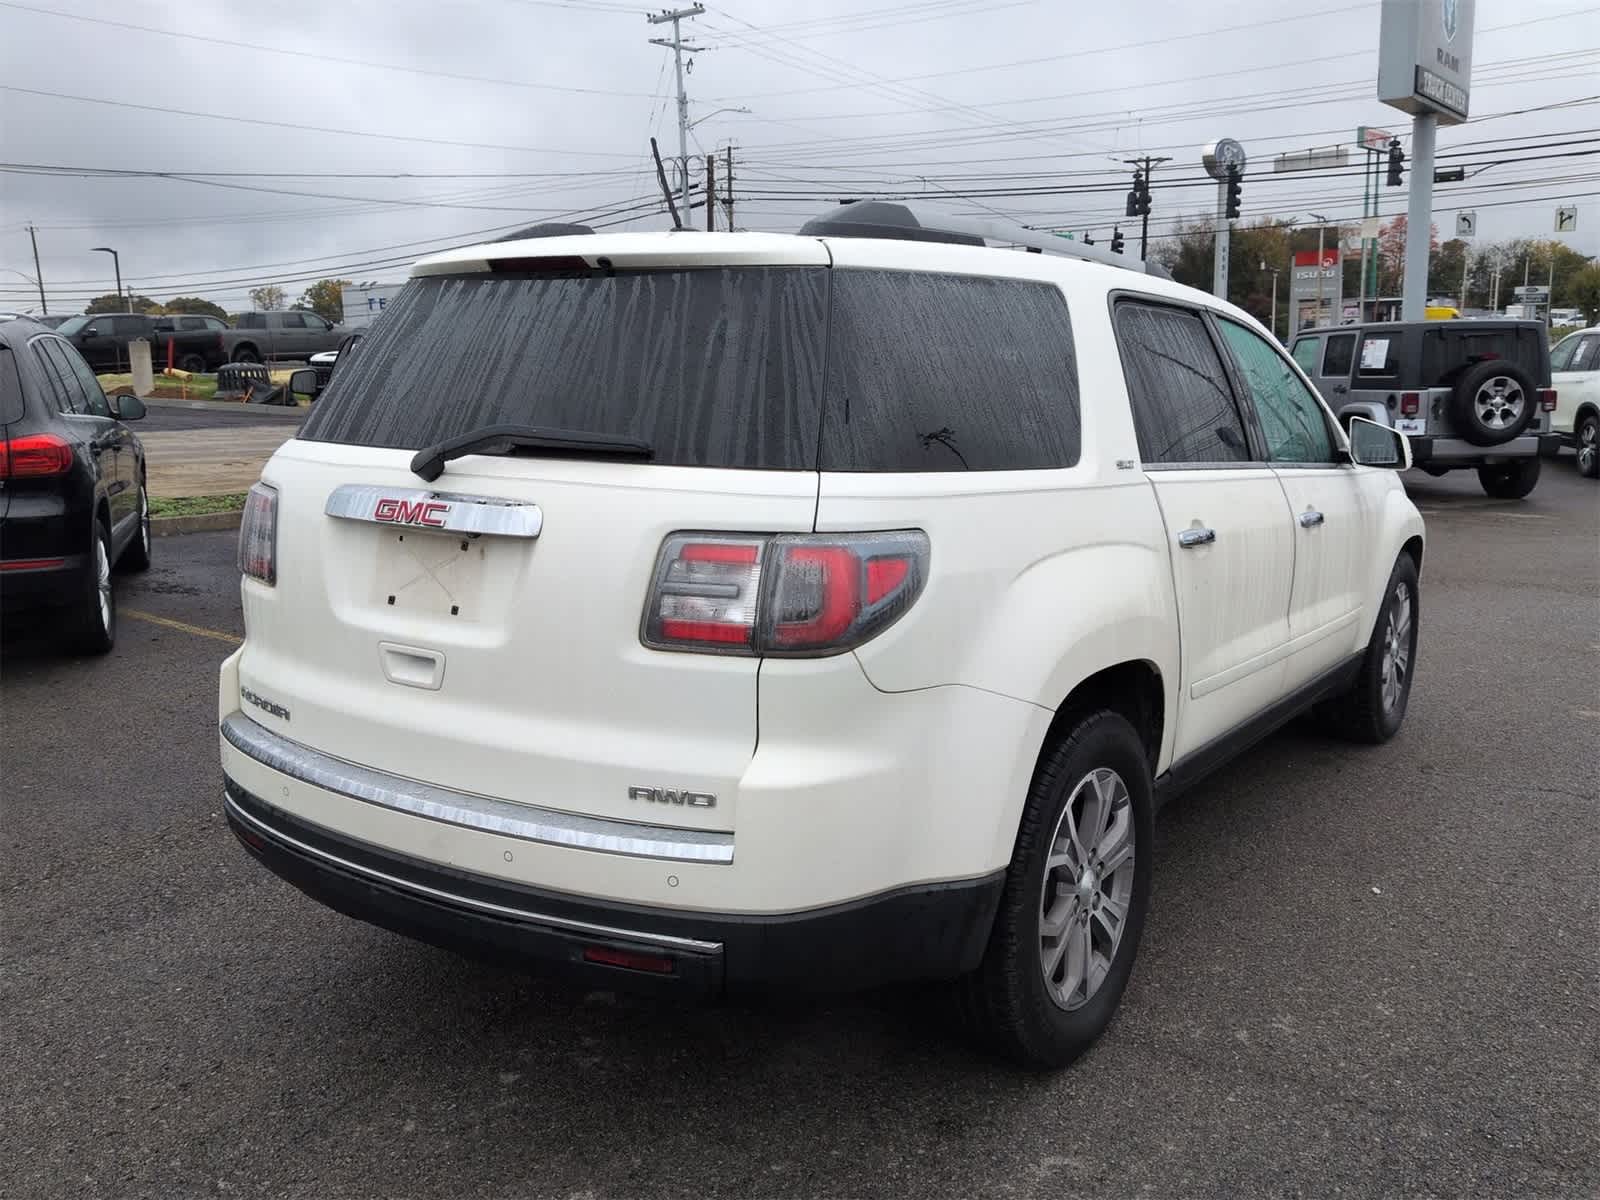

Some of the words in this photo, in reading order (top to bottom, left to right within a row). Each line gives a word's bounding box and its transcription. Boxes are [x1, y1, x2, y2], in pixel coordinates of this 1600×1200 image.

[1436, 47, 1459, 72] RAM
[1423, 71, 1444, 101] TRUCK
[1444, 82, 1466, 113] CENTER
[1296, 269, 1336, 280] ISUZU
[374, 498, 451, 528] GMC
[628, 784, 717, 808] AWD
